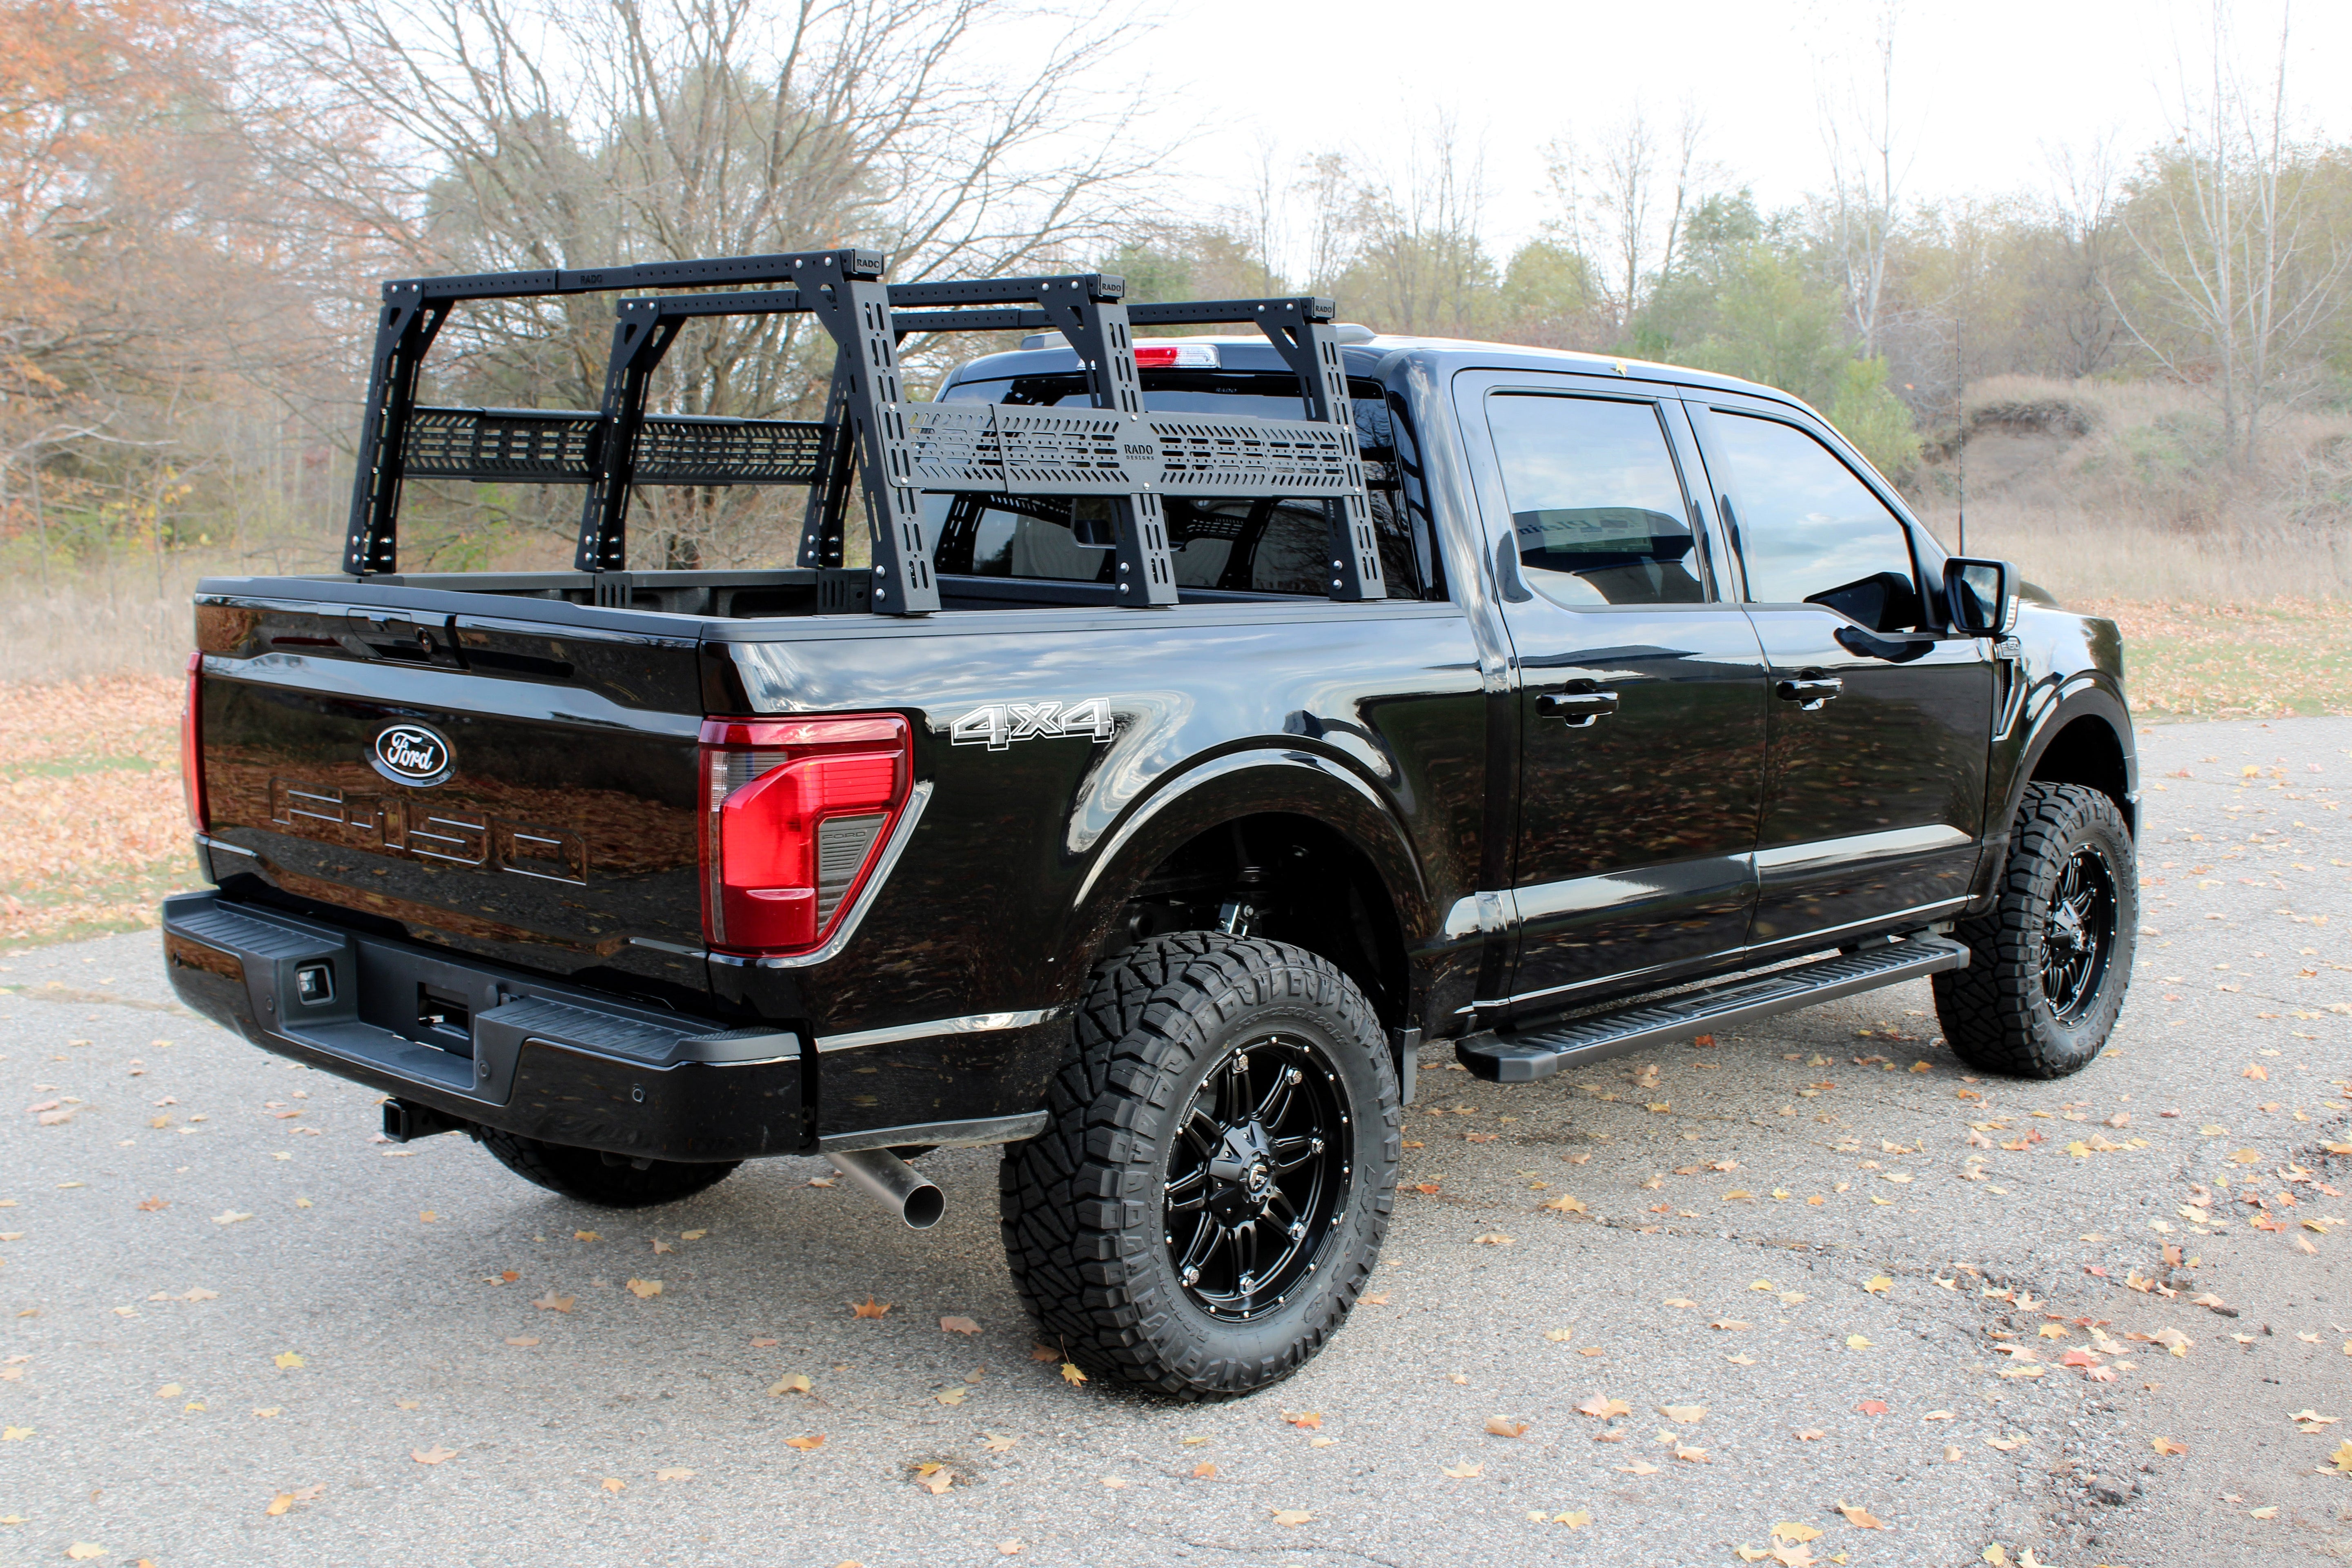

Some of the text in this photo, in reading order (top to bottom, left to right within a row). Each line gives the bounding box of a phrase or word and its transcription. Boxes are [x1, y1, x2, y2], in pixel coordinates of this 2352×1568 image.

[857, 258, 880, 268] RADO
[580, 274, 603, 284] RADO
[1102, 283, 1121, 292] RADO
[1124, 444, 1153, 454] RADO
[386, 731, 435, 771] Ford
[267, 776, 588, 886] F-150
[822, 831, 866, 840] FORD
